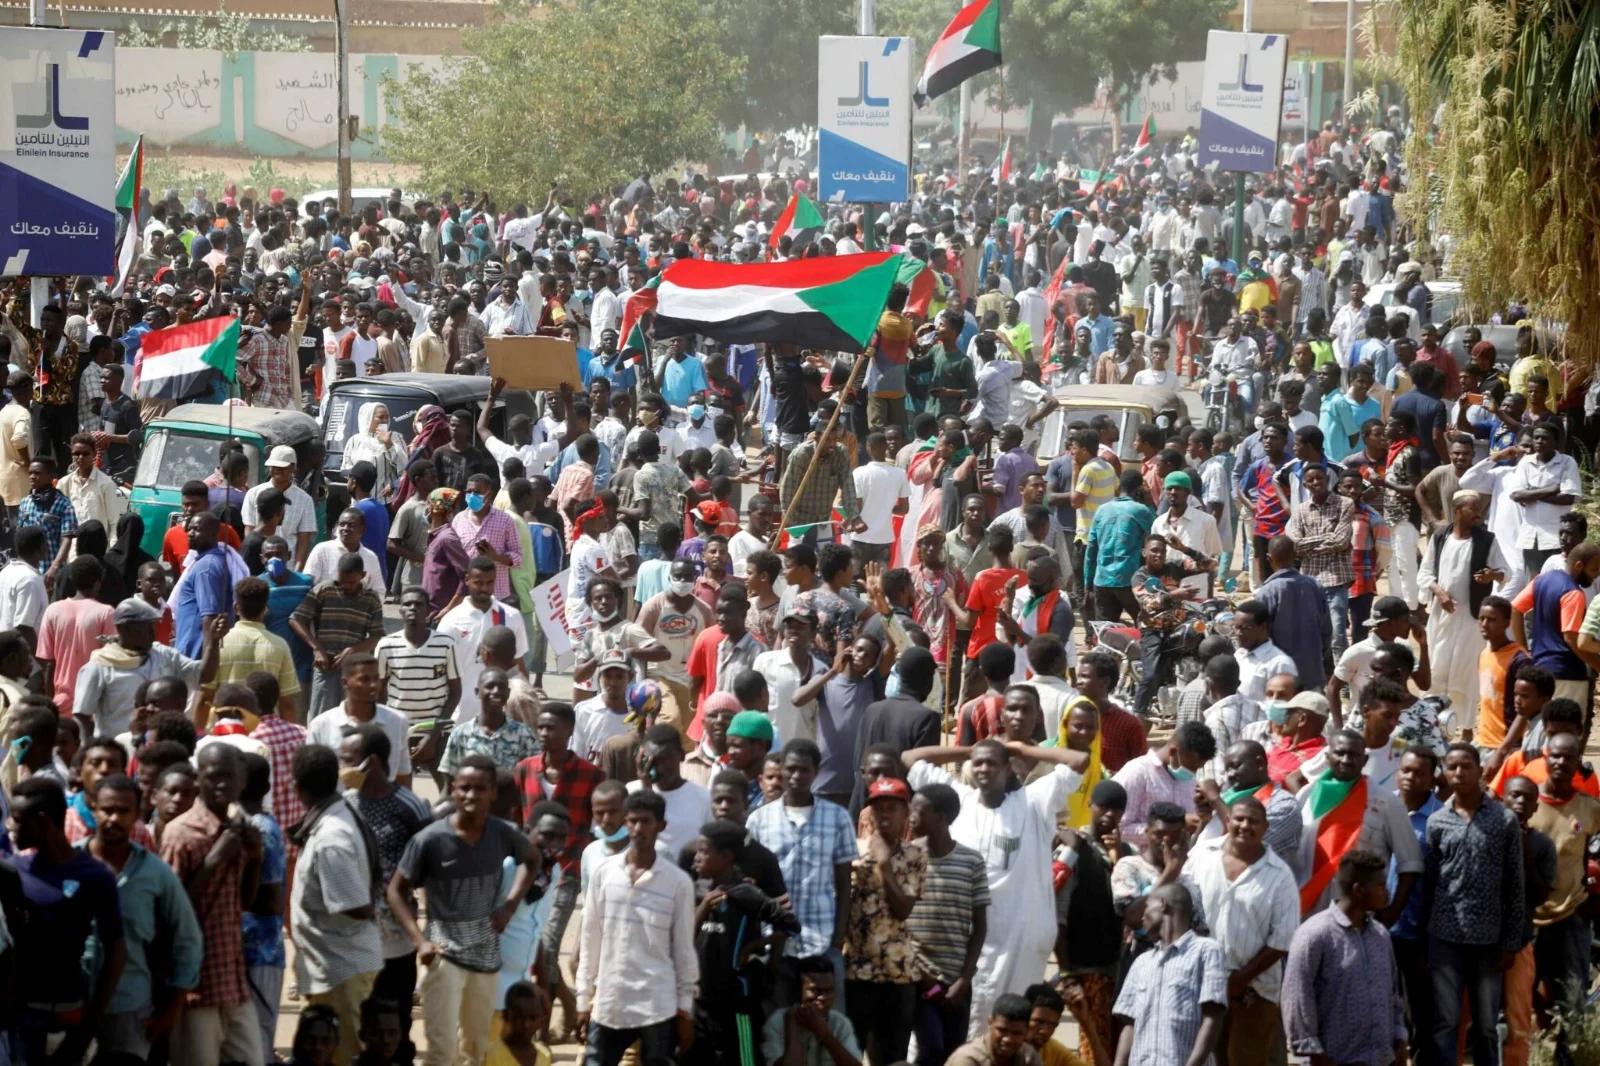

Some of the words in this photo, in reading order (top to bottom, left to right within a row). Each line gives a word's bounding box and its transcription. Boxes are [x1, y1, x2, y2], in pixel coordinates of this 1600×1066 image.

[275, 70, 333, 91] الشهيد
[286, 98, 333, 132] صالح
[57, 133, 89, 147] النيلين
[16, 148, 47, 157] Elnilein
[49, 149, 89, 158] Insurance
[1208, 144, 1234, 154] معاك
[1235, 144, 1265, 157] بنقيف
[831, 171, 861, 181] معاك
[862, 169, 896, 183] بنقيف
[10, 222, 51, 236] معاك
[54, 221, 99, 239] بنقيف
